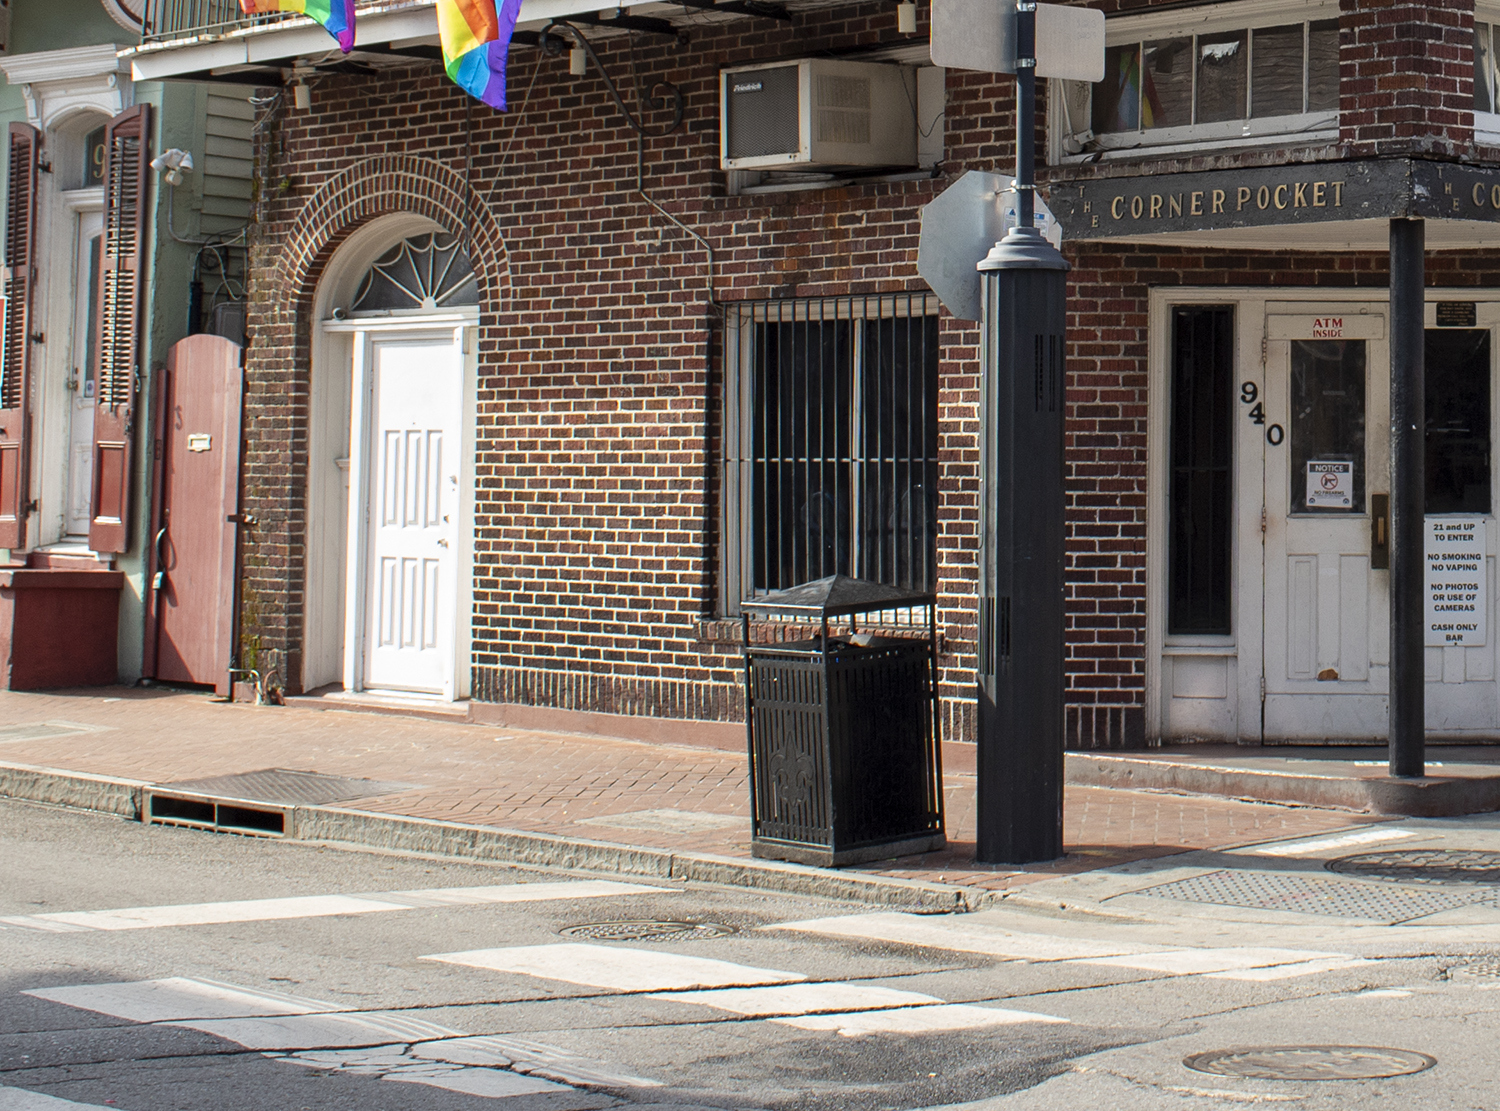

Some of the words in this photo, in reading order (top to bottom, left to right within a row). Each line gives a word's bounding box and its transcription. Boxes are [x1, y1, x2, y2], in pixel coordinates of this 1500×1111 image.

[1437, 166, 1460, 212] THE
[1078, 186, 1099, 228] THE
[1111, 189, 1226, 220] CORNER
[1236, 181, 1346, 211] POCKET
[1313, 318, 1343, 328] ATM
[1313, 330, 1343, 338] INSIDE
[1315, 465, 1344, 473] NOTICE
[1427, 553, 1439, 561] NO
[1442, 553, 1482, 561] SMOKING
[1434, 604, 1475, 612] CAMERAS
[1431, 623, 1454, 631] CASH
[1456, 623, 1478, 631] ONLY
[1446, 634, 1463, 642] BAR
